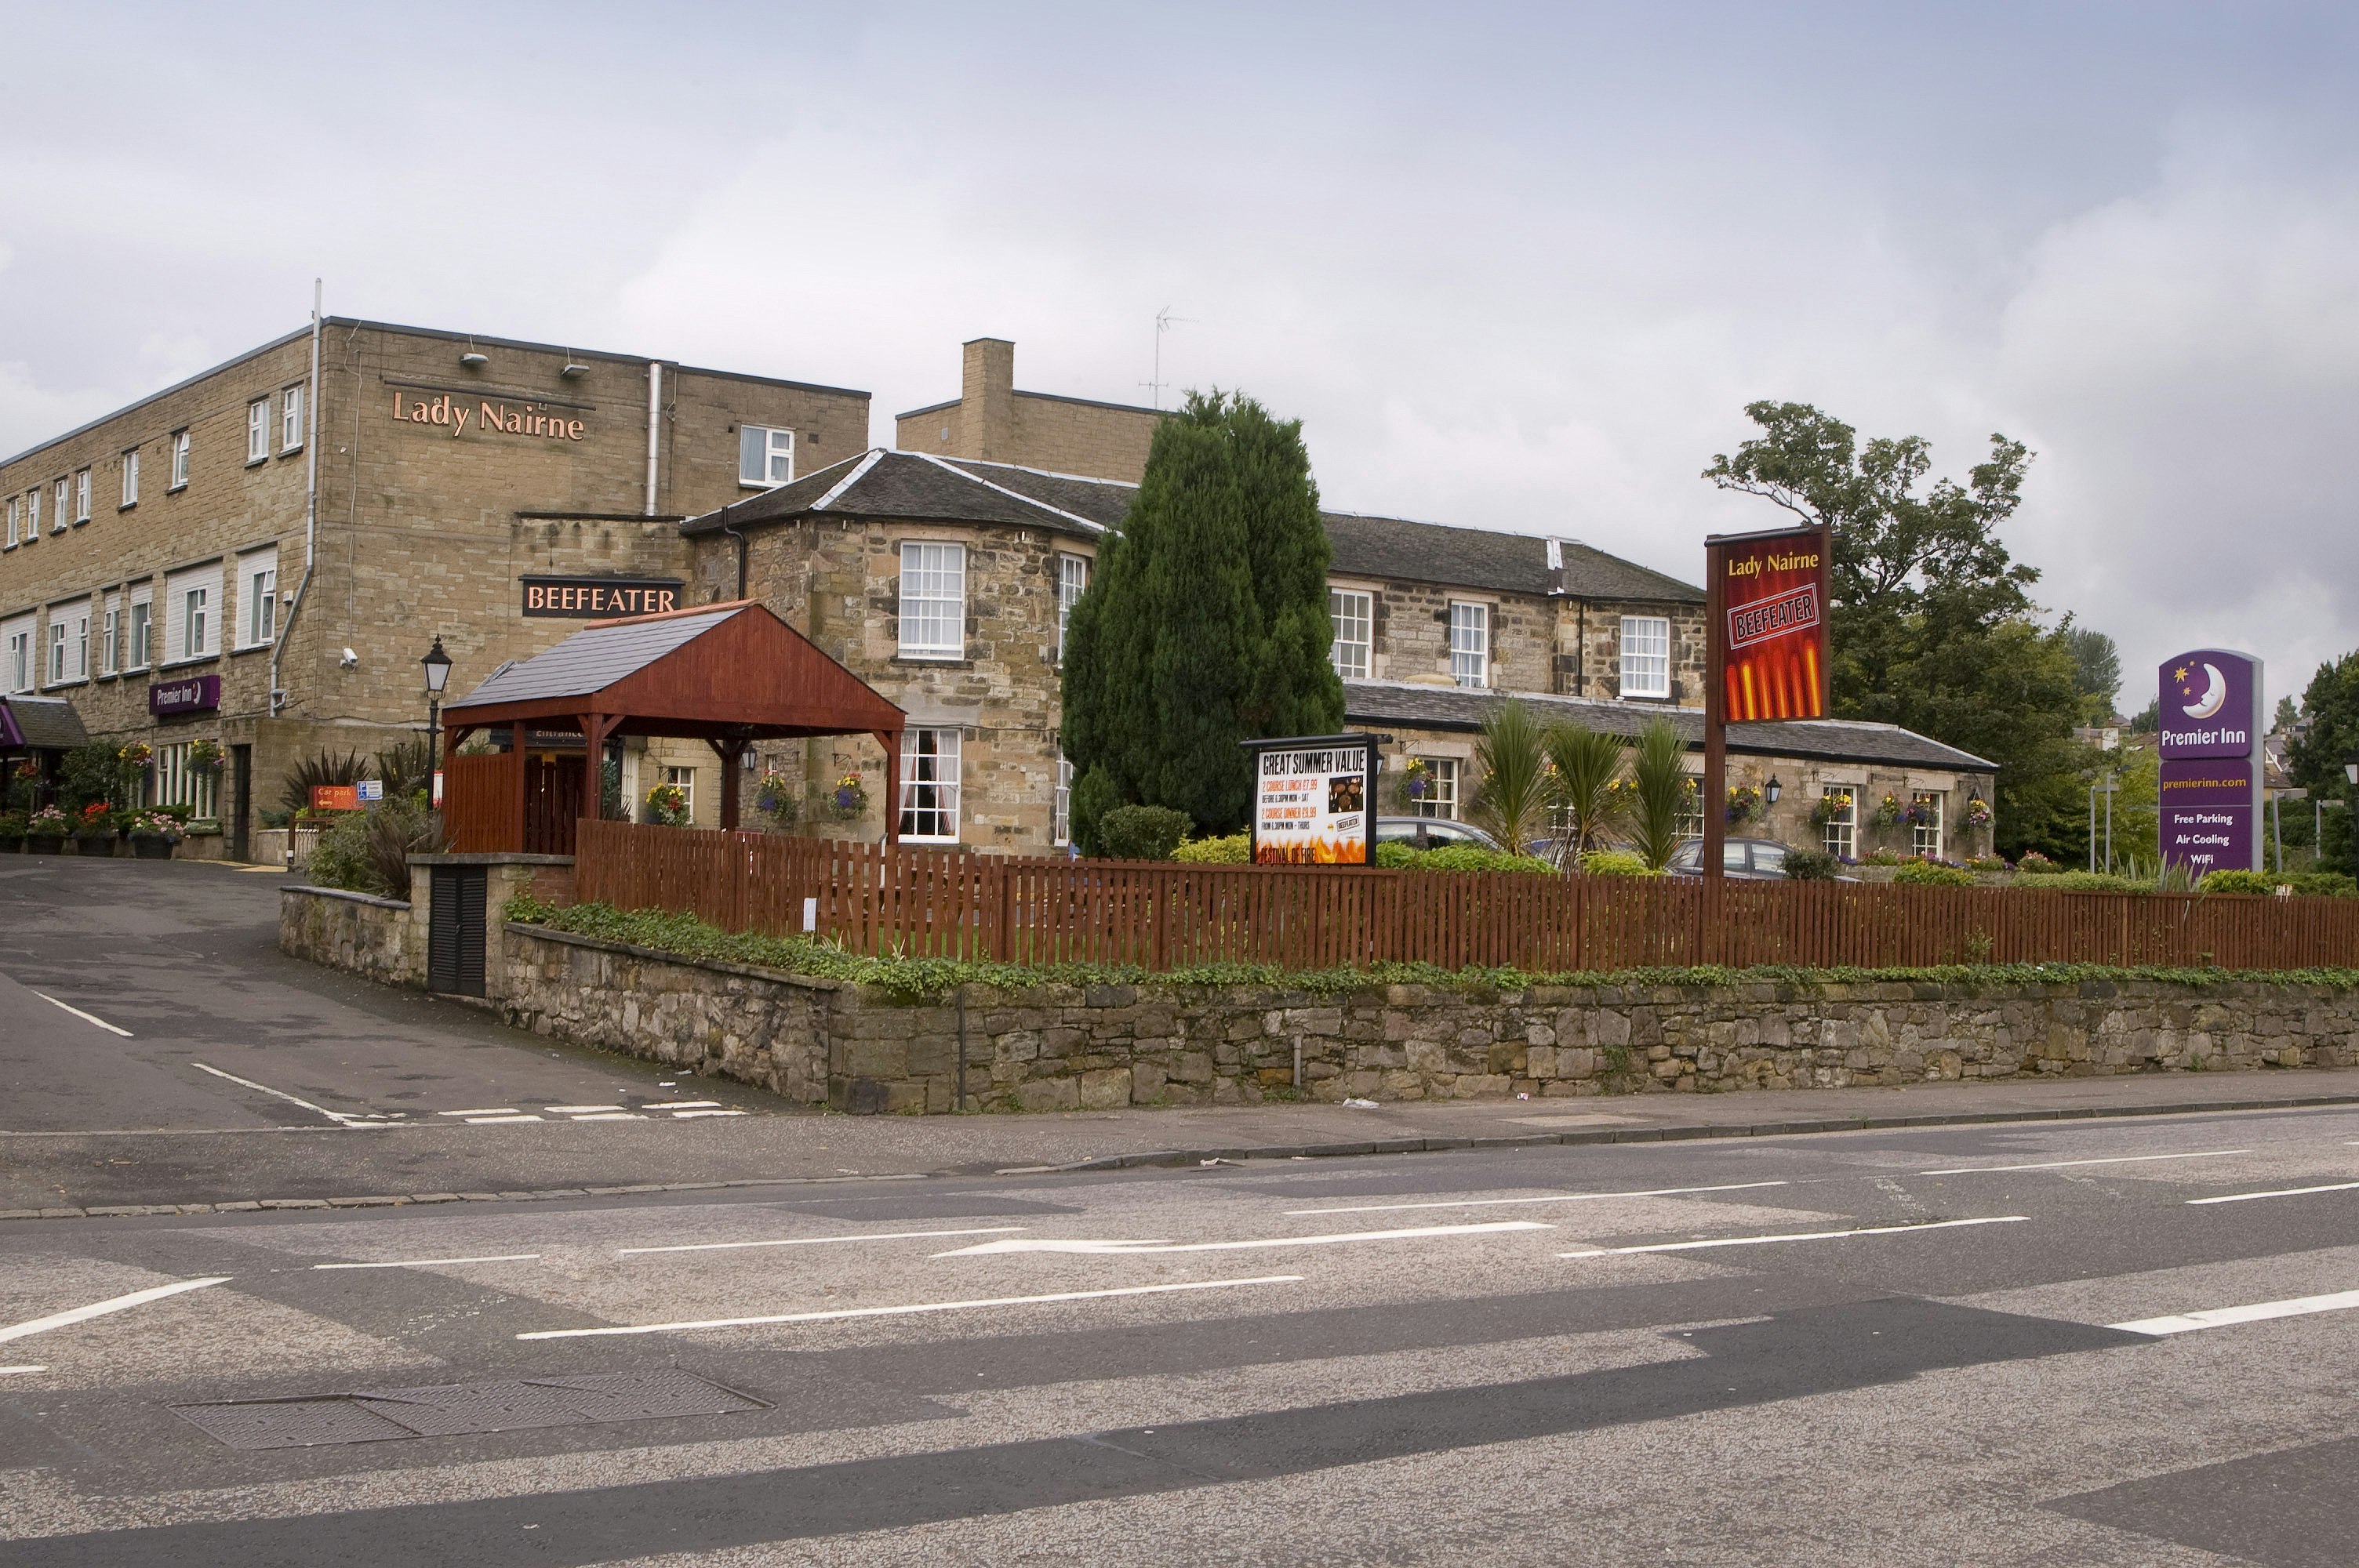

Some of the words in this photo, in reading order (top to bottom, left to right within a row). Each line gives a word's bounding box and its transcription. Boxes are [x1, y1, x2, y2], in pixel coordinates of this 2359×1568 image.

[393, 392, 470, 437] Lady
[480, 401, 584, 440] Nairne
[1728, 555, 1762, 579] Lady
[1768, 551, 1819, 572] Nairne
[528, 586, 674, 612] BEEFEATER
[1736, 594, 1813, 640] BEEFEATER
[157, 687, 180, 706] Premier
[181, 685, 192, 702] Inn
[2161, 728, 2219, 746] Premier
[2221, 728, 2246, 744] Inn
[1263, 754, 1291, 775] GREAT
[1293, 751, 1332, 774] SUMMER
[1336, 750, 1365, 771] VALUE
[1263, 781, 1266, 792] 2
[1267, 780, 1284, 792] COURSE
[1285, 779, 1302, 791] LUNCH
[1303, 779, 1318, 791] £7.99
[2163, 778, 2246, 791] premierinn.com
[334, 788, 351, 798] park
[1262, 808, 1265, 819] 2
[1266, 808, 1282, 819] COURSE
[1284, 807, 1301, 818] DINNER
[1302, 806, 1317, 818] £9.99
[2174, 814, 2194, 824] Free
[2196, 813, 2233, 826] Parking
[2175, 834, 2190, 844] Air
[2192, 833, 2230, 847] Cooling
[1261, 848, 1288, 863] FESTIVAL
[1292, 848, 1299, 863] OF
[1302, 848, 1315, 863] FIRE
[2190, 854, 2214, 864] WiFi
